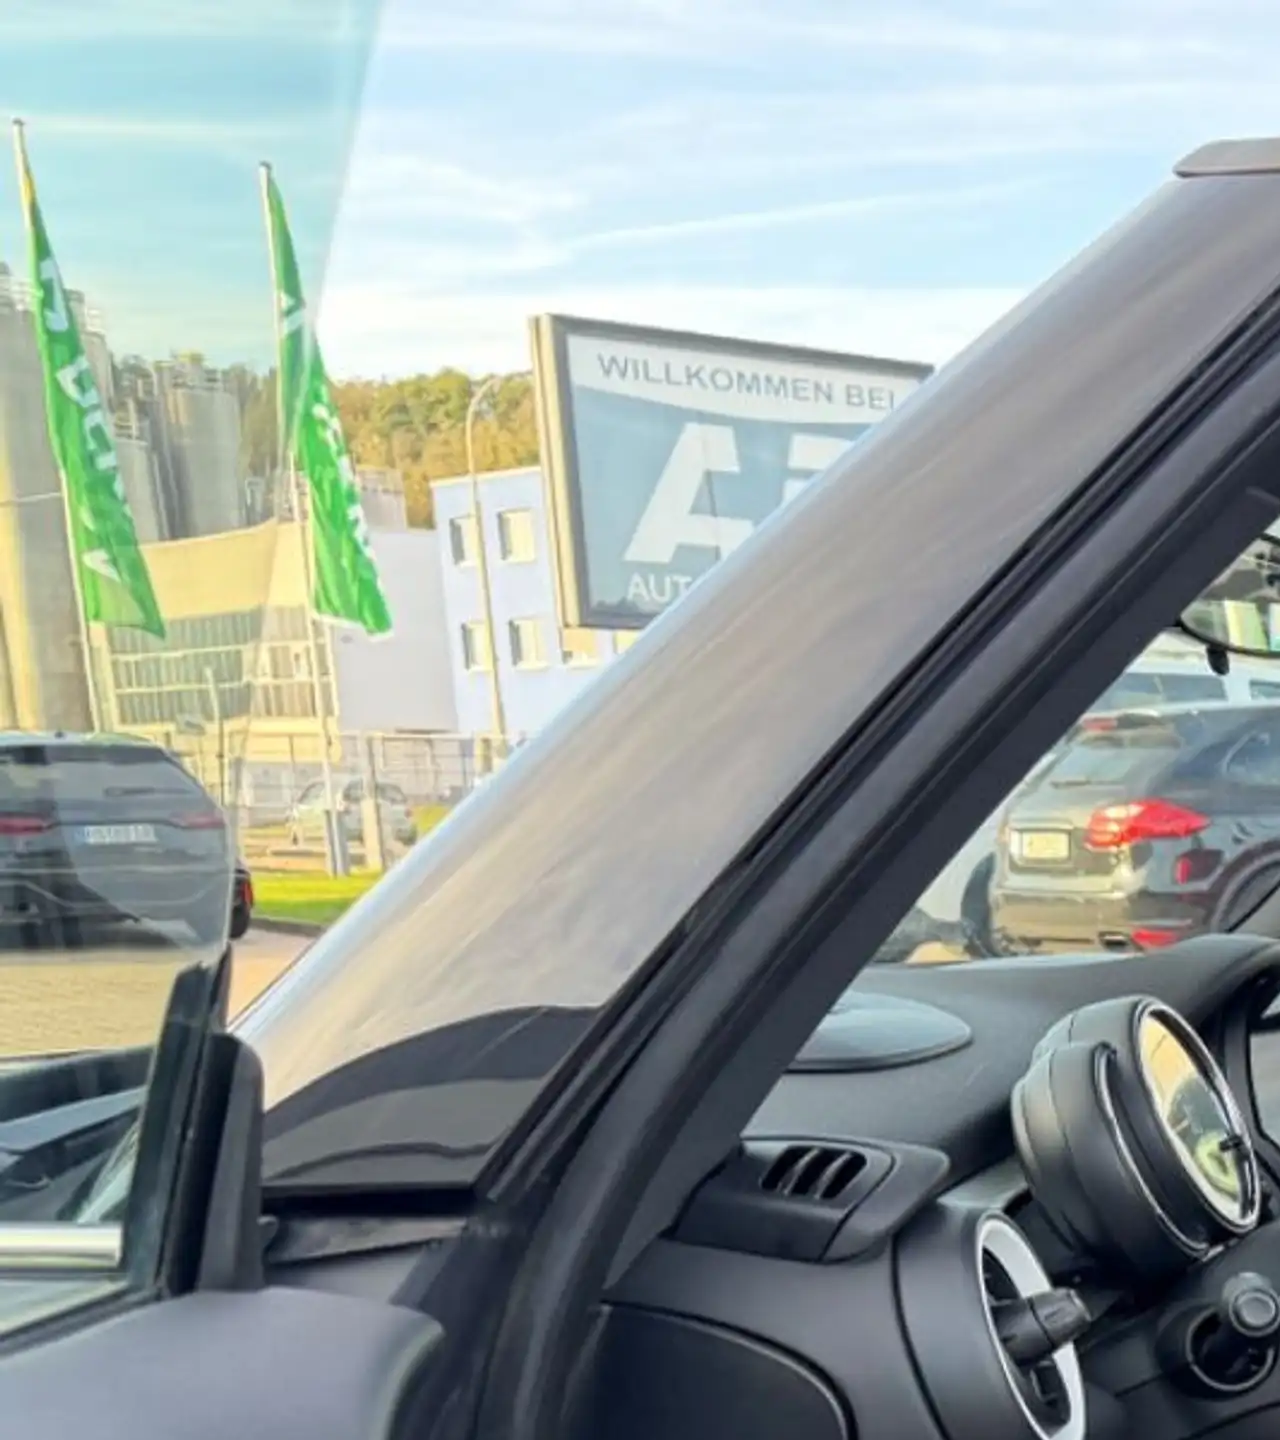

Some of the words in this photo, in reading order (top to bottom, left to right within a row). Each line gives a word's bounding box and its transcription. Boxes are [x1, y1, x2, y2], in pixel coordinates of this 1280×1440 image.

[597, 353, 834, 405] WILLKOMMEN
[844, 383, 896, 412] BEI
[626, 572, 693, 604] AUT
